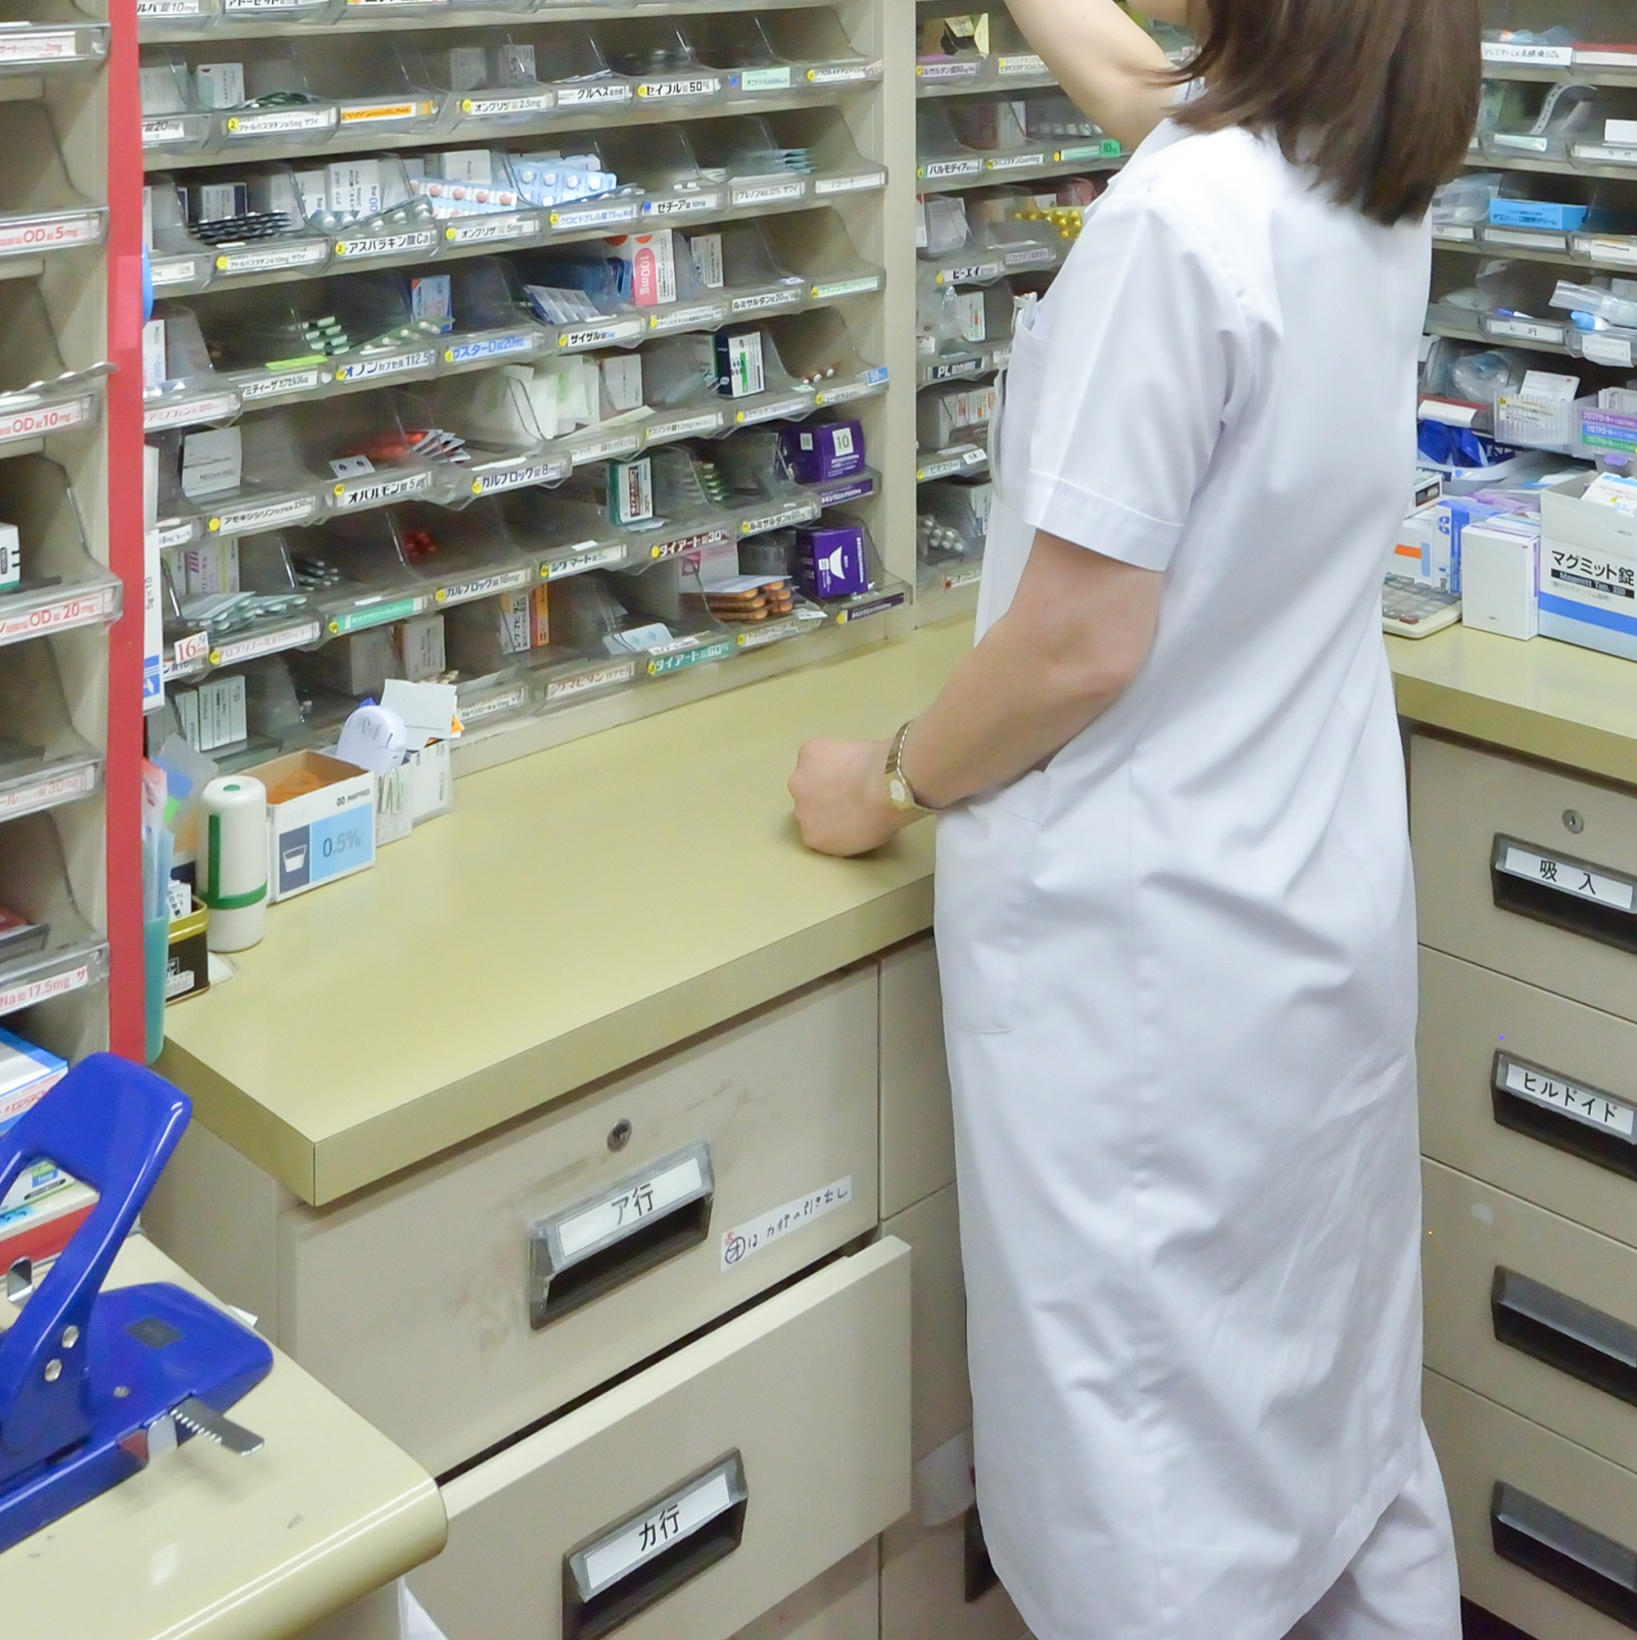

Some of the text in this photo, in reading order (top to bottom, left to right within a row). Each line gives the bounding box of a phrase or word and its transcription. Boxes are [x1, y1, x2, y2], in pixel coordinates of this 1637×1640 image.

[639, 255, 650, 296] 100mg
[837, 436, 849, 449] 10
[1551, 549, 1635, 585] マグミット錠
[323, 830, 361, 860] 0.5%
[1539, 860, 1597, 894] 吸入
[1523, 1074, 1617, 1124] ヒルドイド
[611, 1183, 654, 1224] ア行
[639, 1504, 681, 1550] カ行
